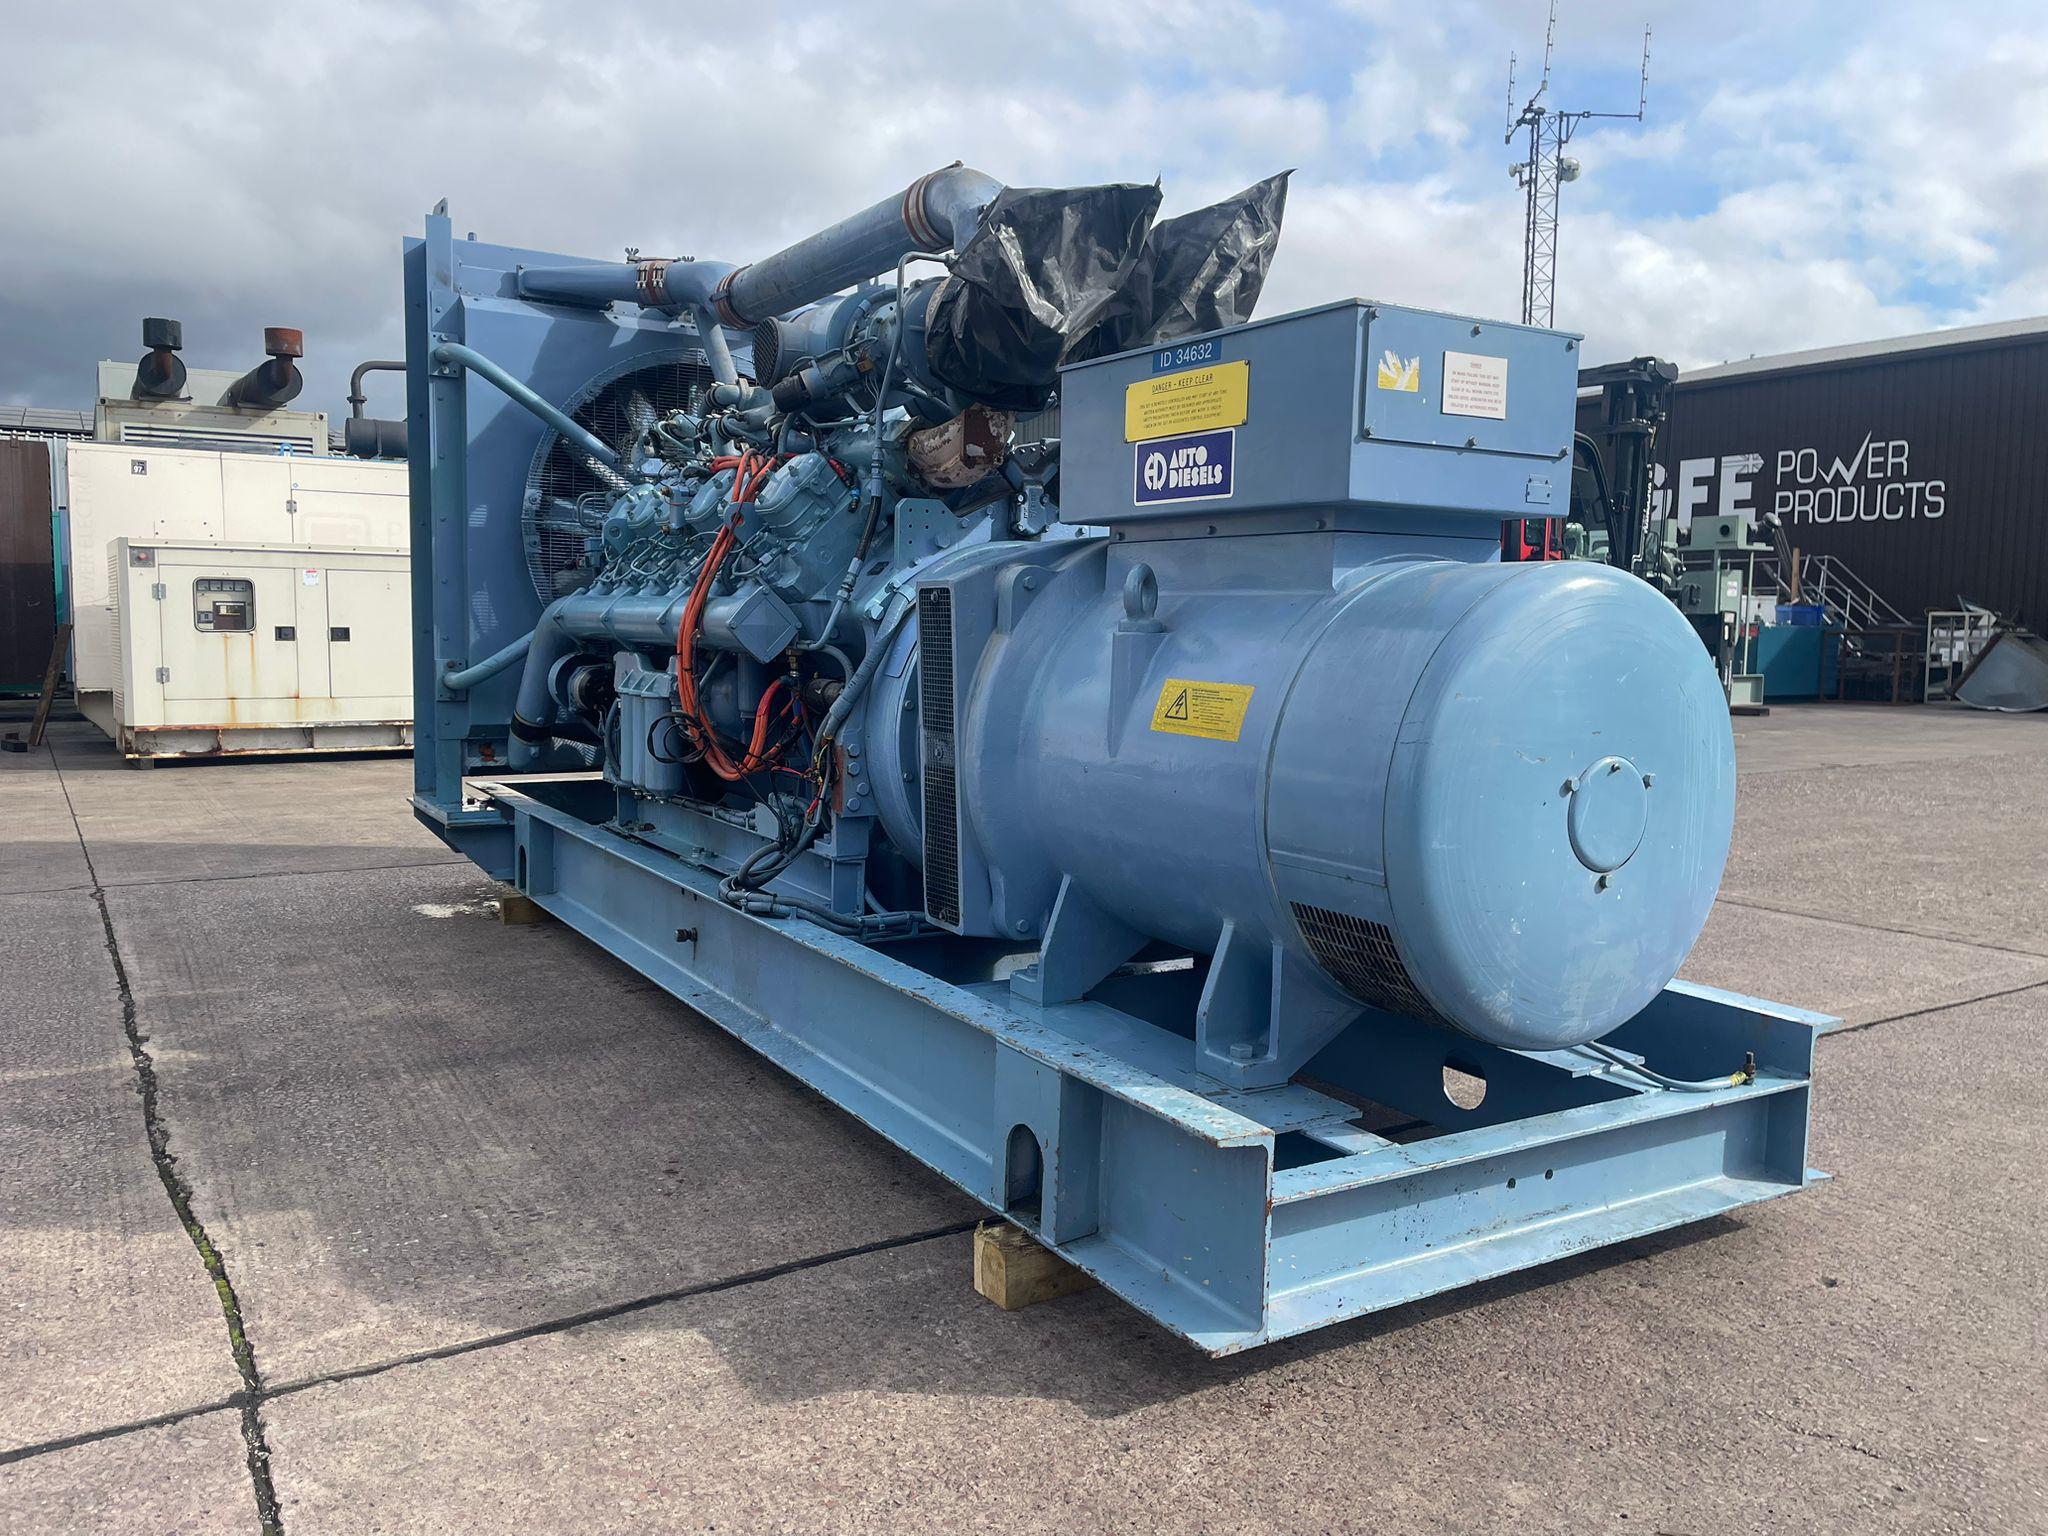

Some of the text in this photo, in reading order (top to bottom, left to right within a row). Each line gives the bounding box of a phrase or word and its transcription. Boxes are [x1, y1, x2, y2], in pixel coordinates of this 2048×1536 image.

[1160, 342, 1213, 368] ID 34632
[1151, 380, 1172, 394] DANGER
[1178, 376, 1194, 388] KEEP
[1194, 373, 1213, 384] CLEAR
[1169, 445, 1208, 469] AUTO
[1776, 430, 1909, 486] POWER
[1169, 463, 1223, 489] DIESELS
[1775, 480, 1945, 525] PRODUCTS
